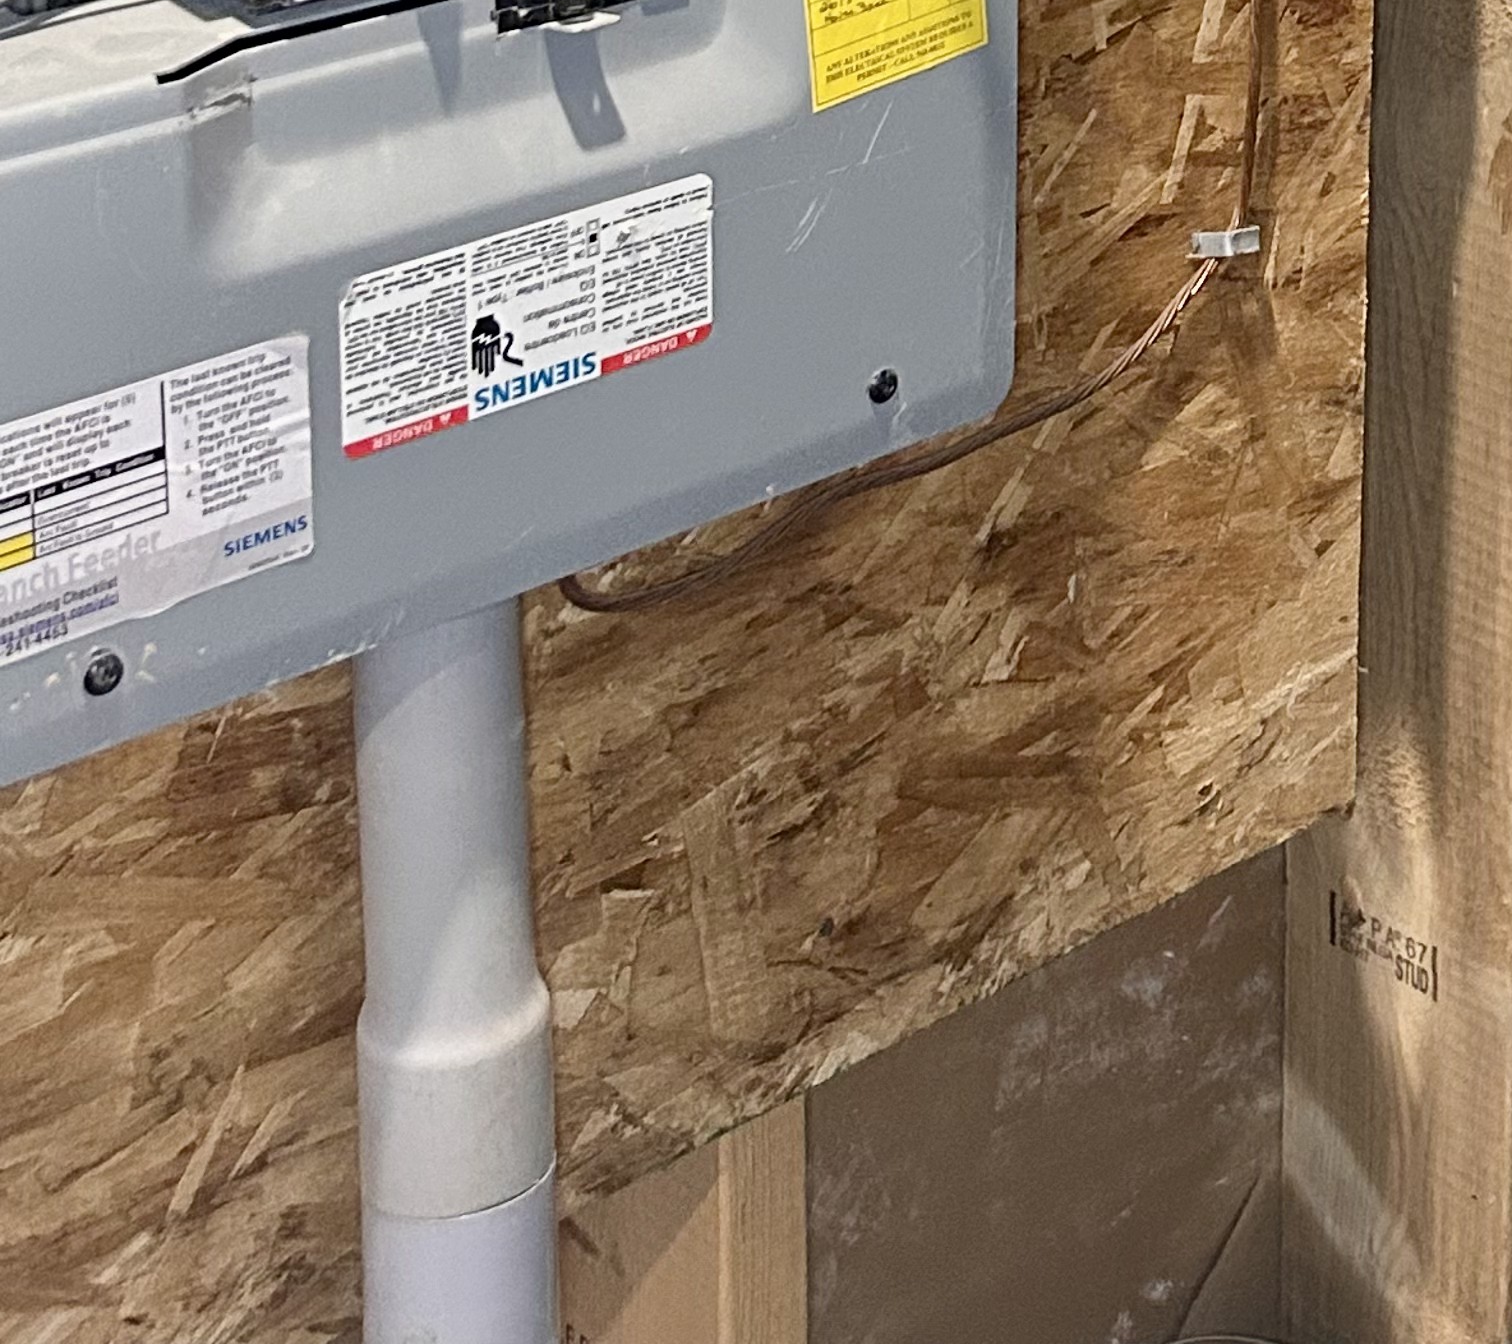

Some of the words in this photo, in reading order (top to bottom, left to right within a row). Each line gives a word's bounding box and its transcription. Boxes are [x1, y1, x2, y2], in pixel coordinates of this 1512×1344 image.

[844, 49, 894, 77] ELECTRICAL
[551, 263, 595, 288] Enclosure
[579, 276, 595, 293] EQ
[522, 291, 595, 325] Consommation
[547, 317, 560, 331] de
[563, 306, 595, 327] Centre
[523, 326, 577, 353] Loadcentre
[622, 334, 678, 365] DANGER
[169, 379, 218, 403] condition
[219, 373, 238, 387] can
[253, 355, 291, 375] cleared
[170, 374, 189, 390] The
[190, 368, 210, 383] last
[211, 358, 245, 377] known
[473, 350, 596, 413] SIEMENS
[170, 402, 182, 416] by
[185, 396, 201, 409] the
[203, 380, 248, 405] following
[196, 404, 219, 421] Turn
[221, 399, 237, 412] the
[239, 389, 263, 407] AFCI
[2, 440, 26, 455] each
[30, 432, 52, 447] time
[54, 425, 71, 439] the
[74, 415, 99, 433] AFCI
[23, 446, 43, 461] and
[66, 426, 103, 449] display
[105, 417, 131, 434] each
[197, 427, 225, 444] Press
[229, 420, 248, 435] and
[249, 412, 270, 428] hold
[198, 418, 214, 432] the
[371, 417, 433, 450] DANGER
[198, 443, 214, 456] the
[216, 434, 235, 449] PTT
[198, 453, 221, 469] Turn
[223, 448, 239, 461] the
[241, 438, 265, 455] AFCI
[1, 460, 41, 481] breaker
[55, 446, 82, 463] reset
[6, 475, 30, 492] after
[32, 469, 49, 483] the
[50, 462, 69, 477] last
[200, 467, 216, 481] the
[200, 472, 239, 494] Release
[241, 466, 258, 480] the
[259, 457, 280, 473] PTT
[202, 486, 233, 505] button
[236, 475, 265, 492] within
[223, 513, 308, 559] SIEMENS
[0, 557, 59, 608] anch
[68, 521, 162, 584] Feeder
[62, 574, 118, 606] Checklist
[1395, 954, 1429, 994] STUD
